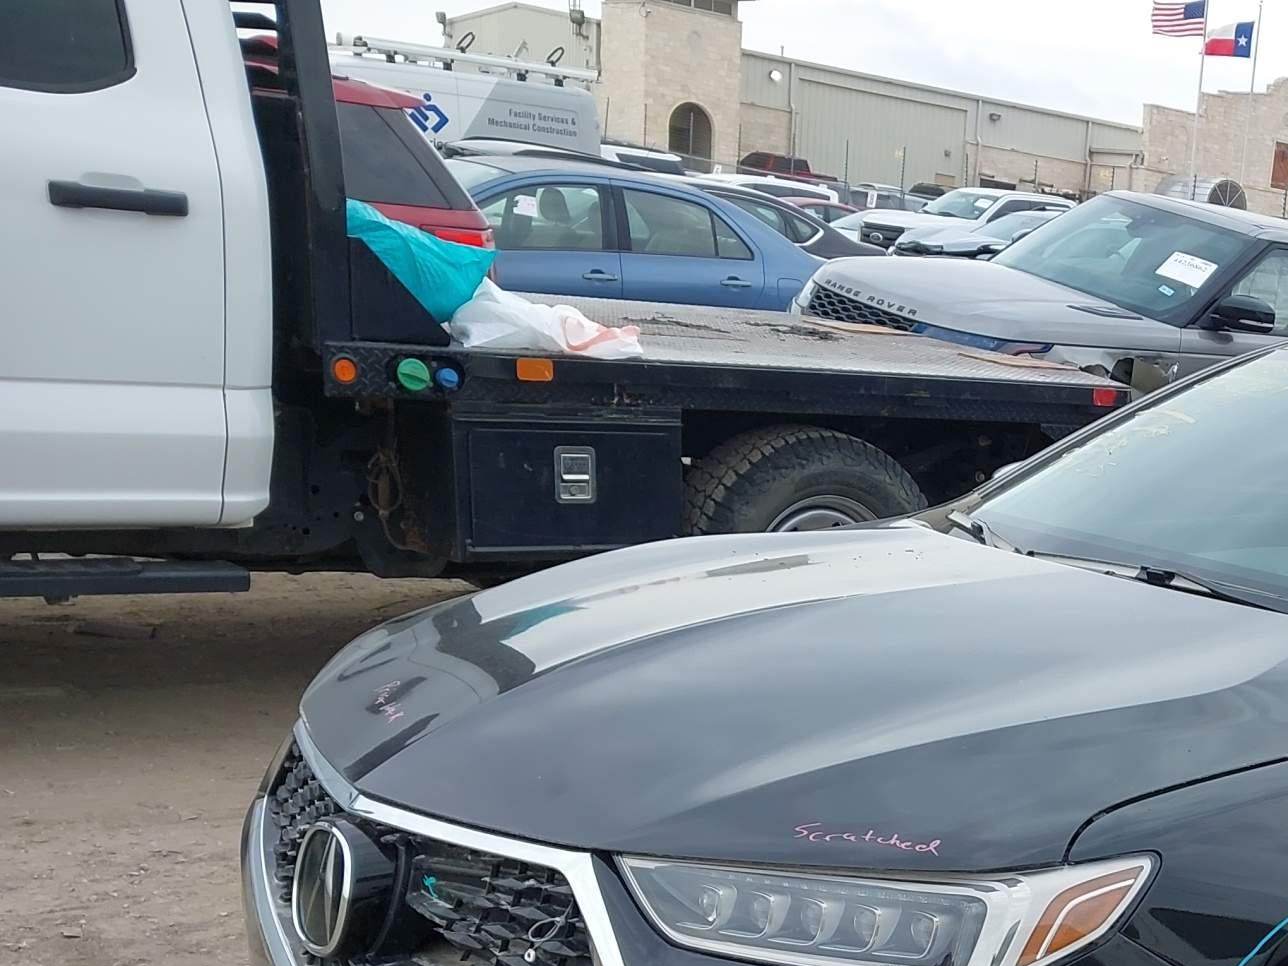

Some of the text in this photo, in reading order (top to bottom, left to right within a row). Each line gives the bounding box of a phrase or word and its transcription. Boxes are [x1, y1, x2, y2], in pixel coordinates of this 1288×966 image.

[487, 117, 577, 137] Mechanical Construction
[508, 108, 577, 126] Facility Services &
[824, 279, 918, 317] RANGE ROVER
[794, 822, 942, 857] Scratched
